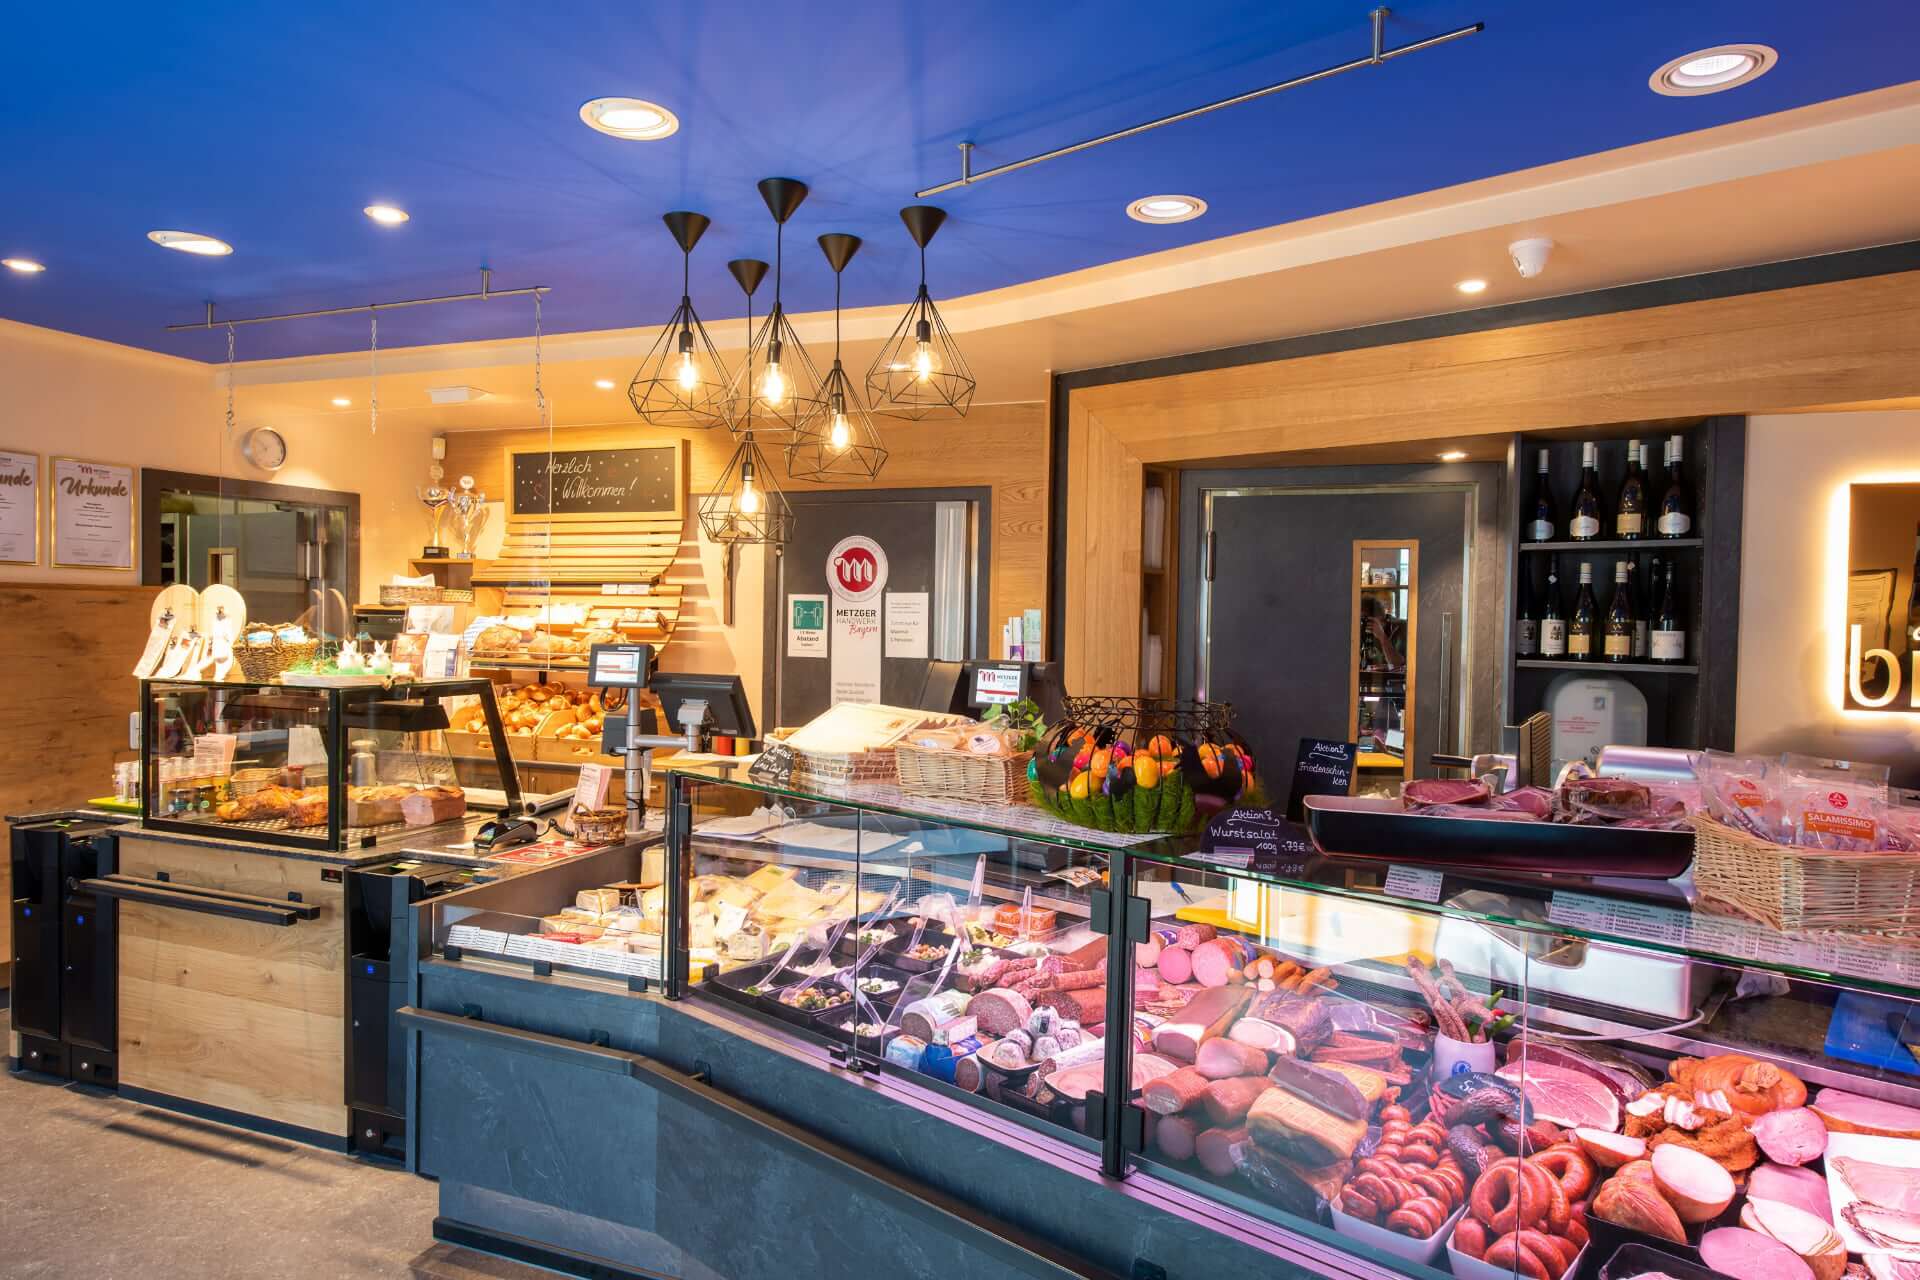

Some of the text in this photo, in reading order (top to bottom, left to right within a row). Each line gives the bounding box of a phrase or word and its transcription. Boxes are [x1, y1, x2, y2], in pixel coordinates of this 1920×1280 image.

[545, 455, 592, 474] Herzlich
[60, 476, 128, 497] Urkunde
[836, 609, 877, 617] METZGER
[836, 617, 877, 625] HANDWERK
[848, 624, 878, 639] Bayern
[1807, 813, 1872, 829] SALAMISSIMO
[1210, 825, 1279, 840] Wurstsalat
